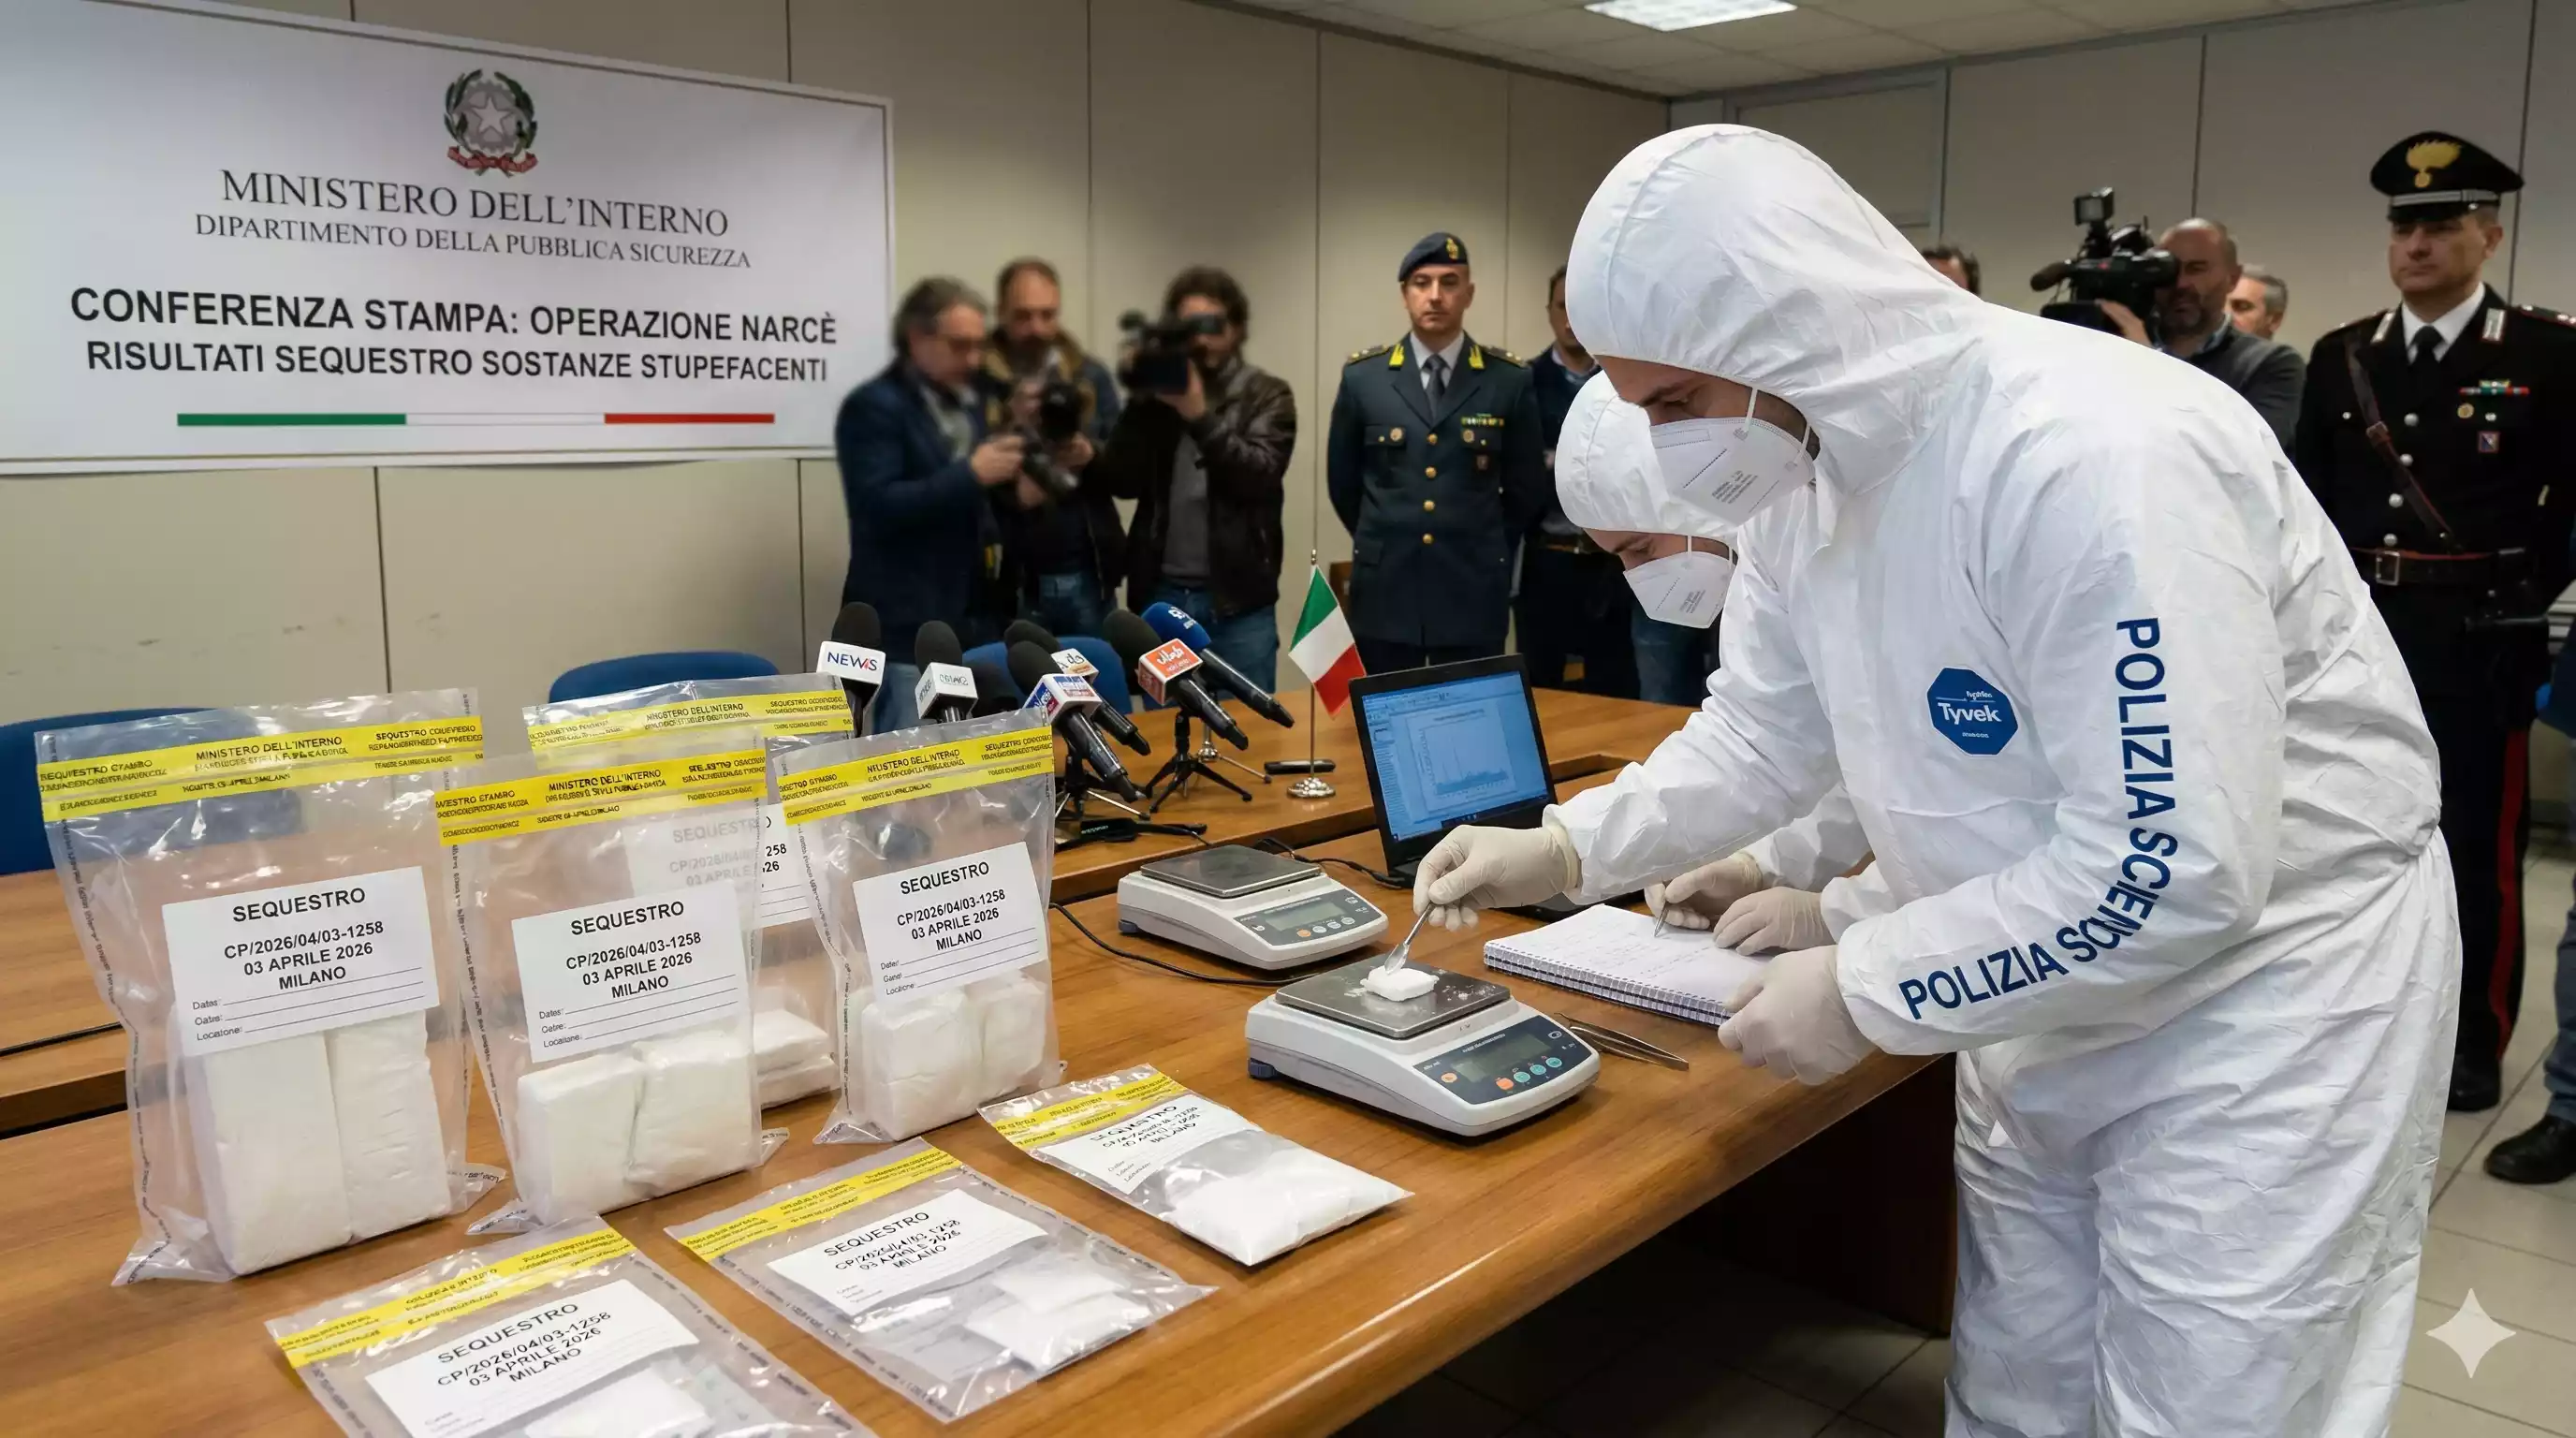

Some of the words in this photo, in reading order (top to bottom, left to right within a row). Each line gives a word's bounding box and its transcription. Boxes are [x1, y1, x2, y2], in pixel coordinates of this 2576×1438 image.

[220, 169, 458, 217] MINISTERO
[470, 189, 728, 237] DELL'INTERNO
[196, 213, 407, 247] DIPARTIMENTO
[416, 228, 499, 253] DELLA
[506, 234, 624, 261] PUBBLICA
[630, 242, 751, 268] SICUREZZA
[71, 286, 354, 330] CONFERENZA
[364, 299, 518, 334] STAMPA:
[530, 305, 732, 341] OPERAZIONE
[741, 311, 837, 344] NARCÈ
[86, 340, 264, 373] RISULTATI
[274, 345, 473, 375] SEQUESTRO
[481, 349, 633, 378] SOSTANZE
[640, 353, 827, 382] STUPEFACENTI
[1938, 702, 2003, 726] Tyvek
[2115, 617, 2176, 820] POLIZIA
[900, 861, 990, 895] SEQUESTRO
[232, 888, 367, 922] SEQUESTRO
[570, 901, 685, 936] SEQUESTRO
[896, 888, 1006, 926] CP/2026/04/03-1258
[911, 928, 926, 940] 03
[928, 915, 971, 936] APRILE
[973, 907, 1000, 924] 2026
[224, 920, 385, 960] CP/2026/04/03-1258
[243, 959, 264, 976] 03
[269, 948, 331, 973] APRILE
[335, 941, 374, 961] 2026
[565, 932, 702, 970] CP/2026/04/03-1258
[935, 929, 983, 951] MILANO
[278, 966, 347, 990] MILANO
[582, 971, 600, 986] 03
[604, 958, 657, 982] APRILE
[661, 951, 693, 970] 2026
[611, 976, 670, 999] MILANO
[1898, 942, 2070, 1020] POLIZIA
[824, 1211, 929, 1257] SEQUESTRO
[437, 1303, 579, 1365] SEQUESTRO
[437, 1312, 611, 1387] CP/2026/04/03-1258
[469, 1373, 490, 1387] 03
[495, 1343, 561, 1377] APRILE
[561, 1327, 602, 1348] 2026
[509, 1347, 582, 1383] MILANO
